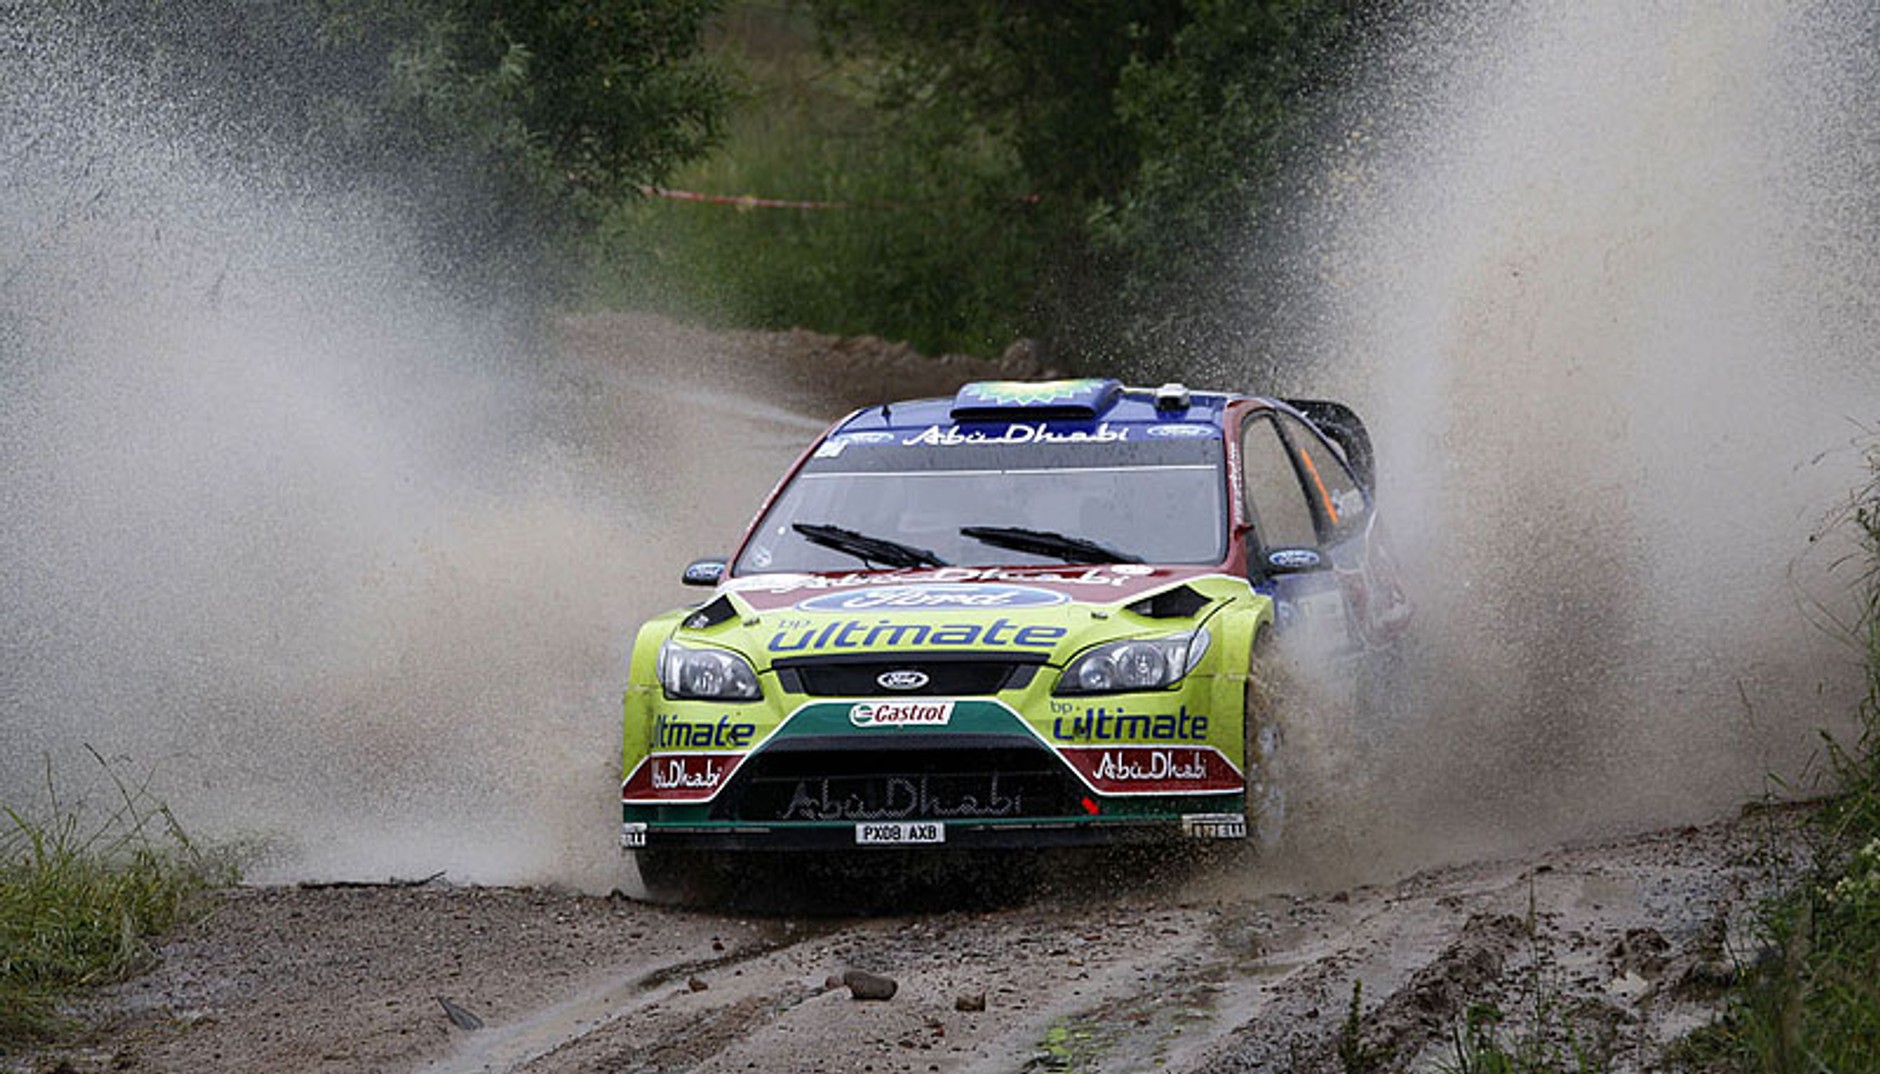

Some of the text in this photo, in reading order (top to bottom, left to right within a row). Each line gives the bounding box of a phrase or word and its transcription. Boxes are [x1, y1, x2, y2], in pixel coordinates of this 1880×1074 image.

[843, 585, 1019, 607] Ford
[768, 618, 1067, 652] ultimate
[875, 704, 946, 722] Castrol
[1050, 701, 1072, 714] bp
[651, 713, 755, 748] ltimate
[1053, 705, 1208, 741] ultimate
[863, 825, 937, 841] PX08 AXB
